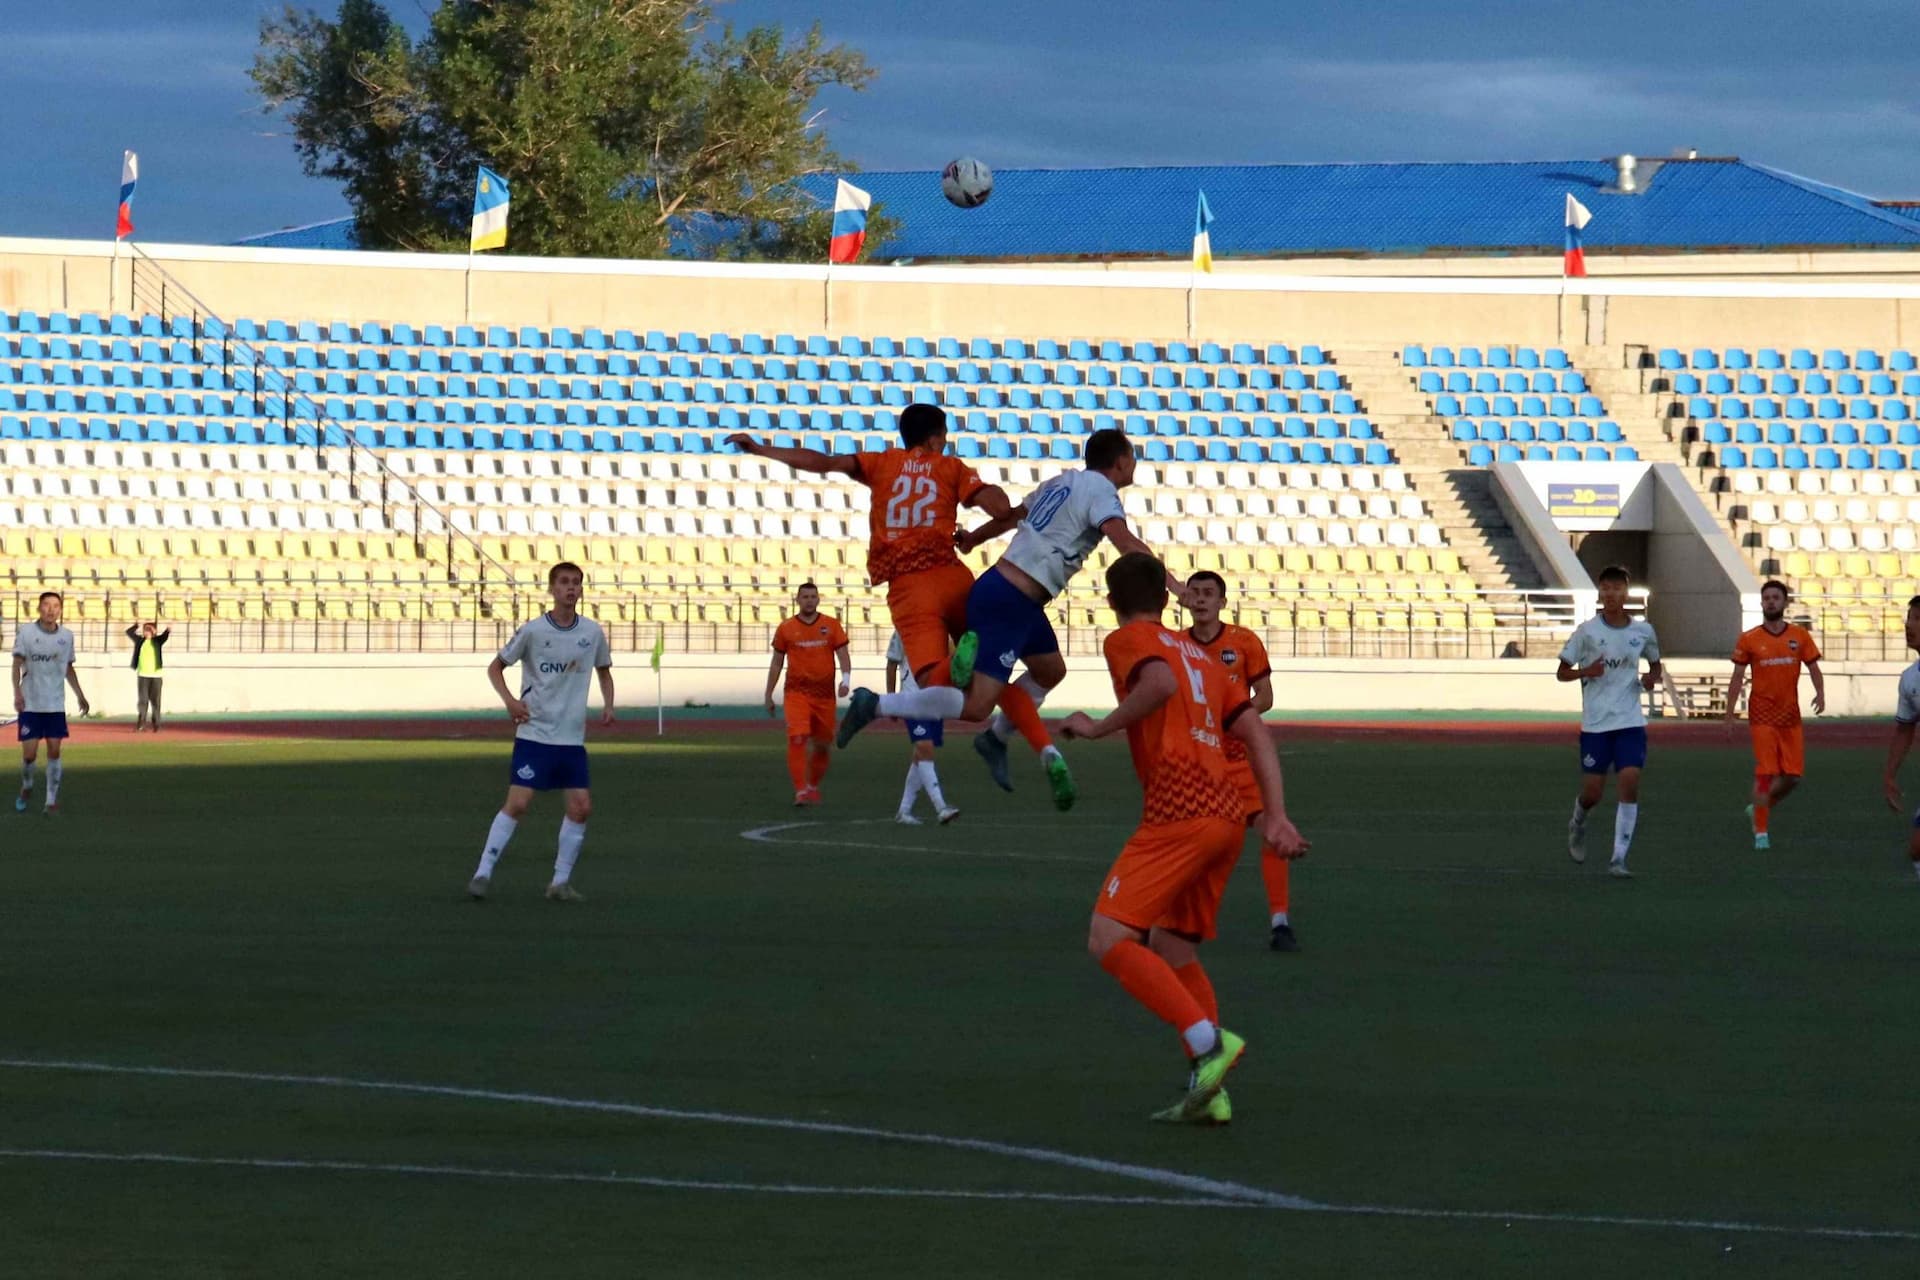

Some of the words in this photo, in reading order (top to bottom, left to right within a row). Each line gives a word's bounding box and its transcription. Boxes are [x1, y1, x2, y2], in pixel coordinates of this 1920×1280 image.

[886, 475, 937, 528] 22
[31, 654, 51, 662] GNV
[540, 662, 568, 673] GNV
[1107, 876, 1120, 898] 4
